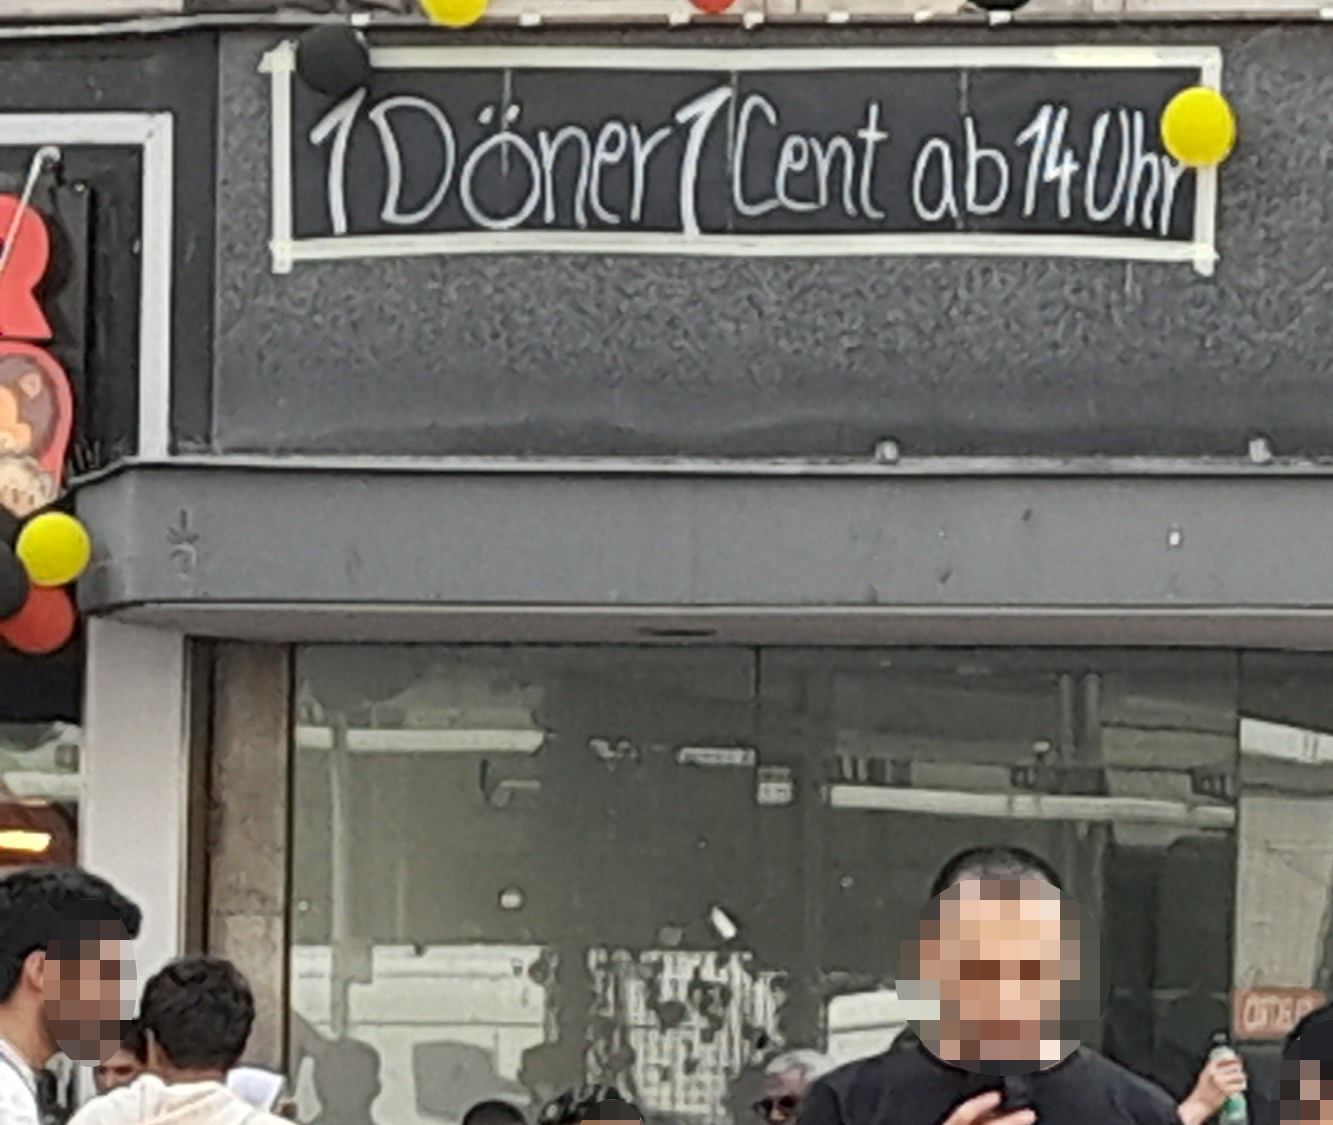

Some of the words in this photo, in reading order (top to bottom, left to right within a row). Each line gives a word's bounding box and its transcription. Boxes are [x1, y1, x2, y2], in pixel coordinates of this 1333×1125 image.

[310, 87, 367, 235] 1
[369, 95, 672, 229] Döner
[674, 85, 734, 237] 1
[732, 94, 889, 220] Cent
[912, 116, 1010, 226] ab
[1015, 104, 1081, 219] 14
[1084, 107, 1188, 237] Uhr
